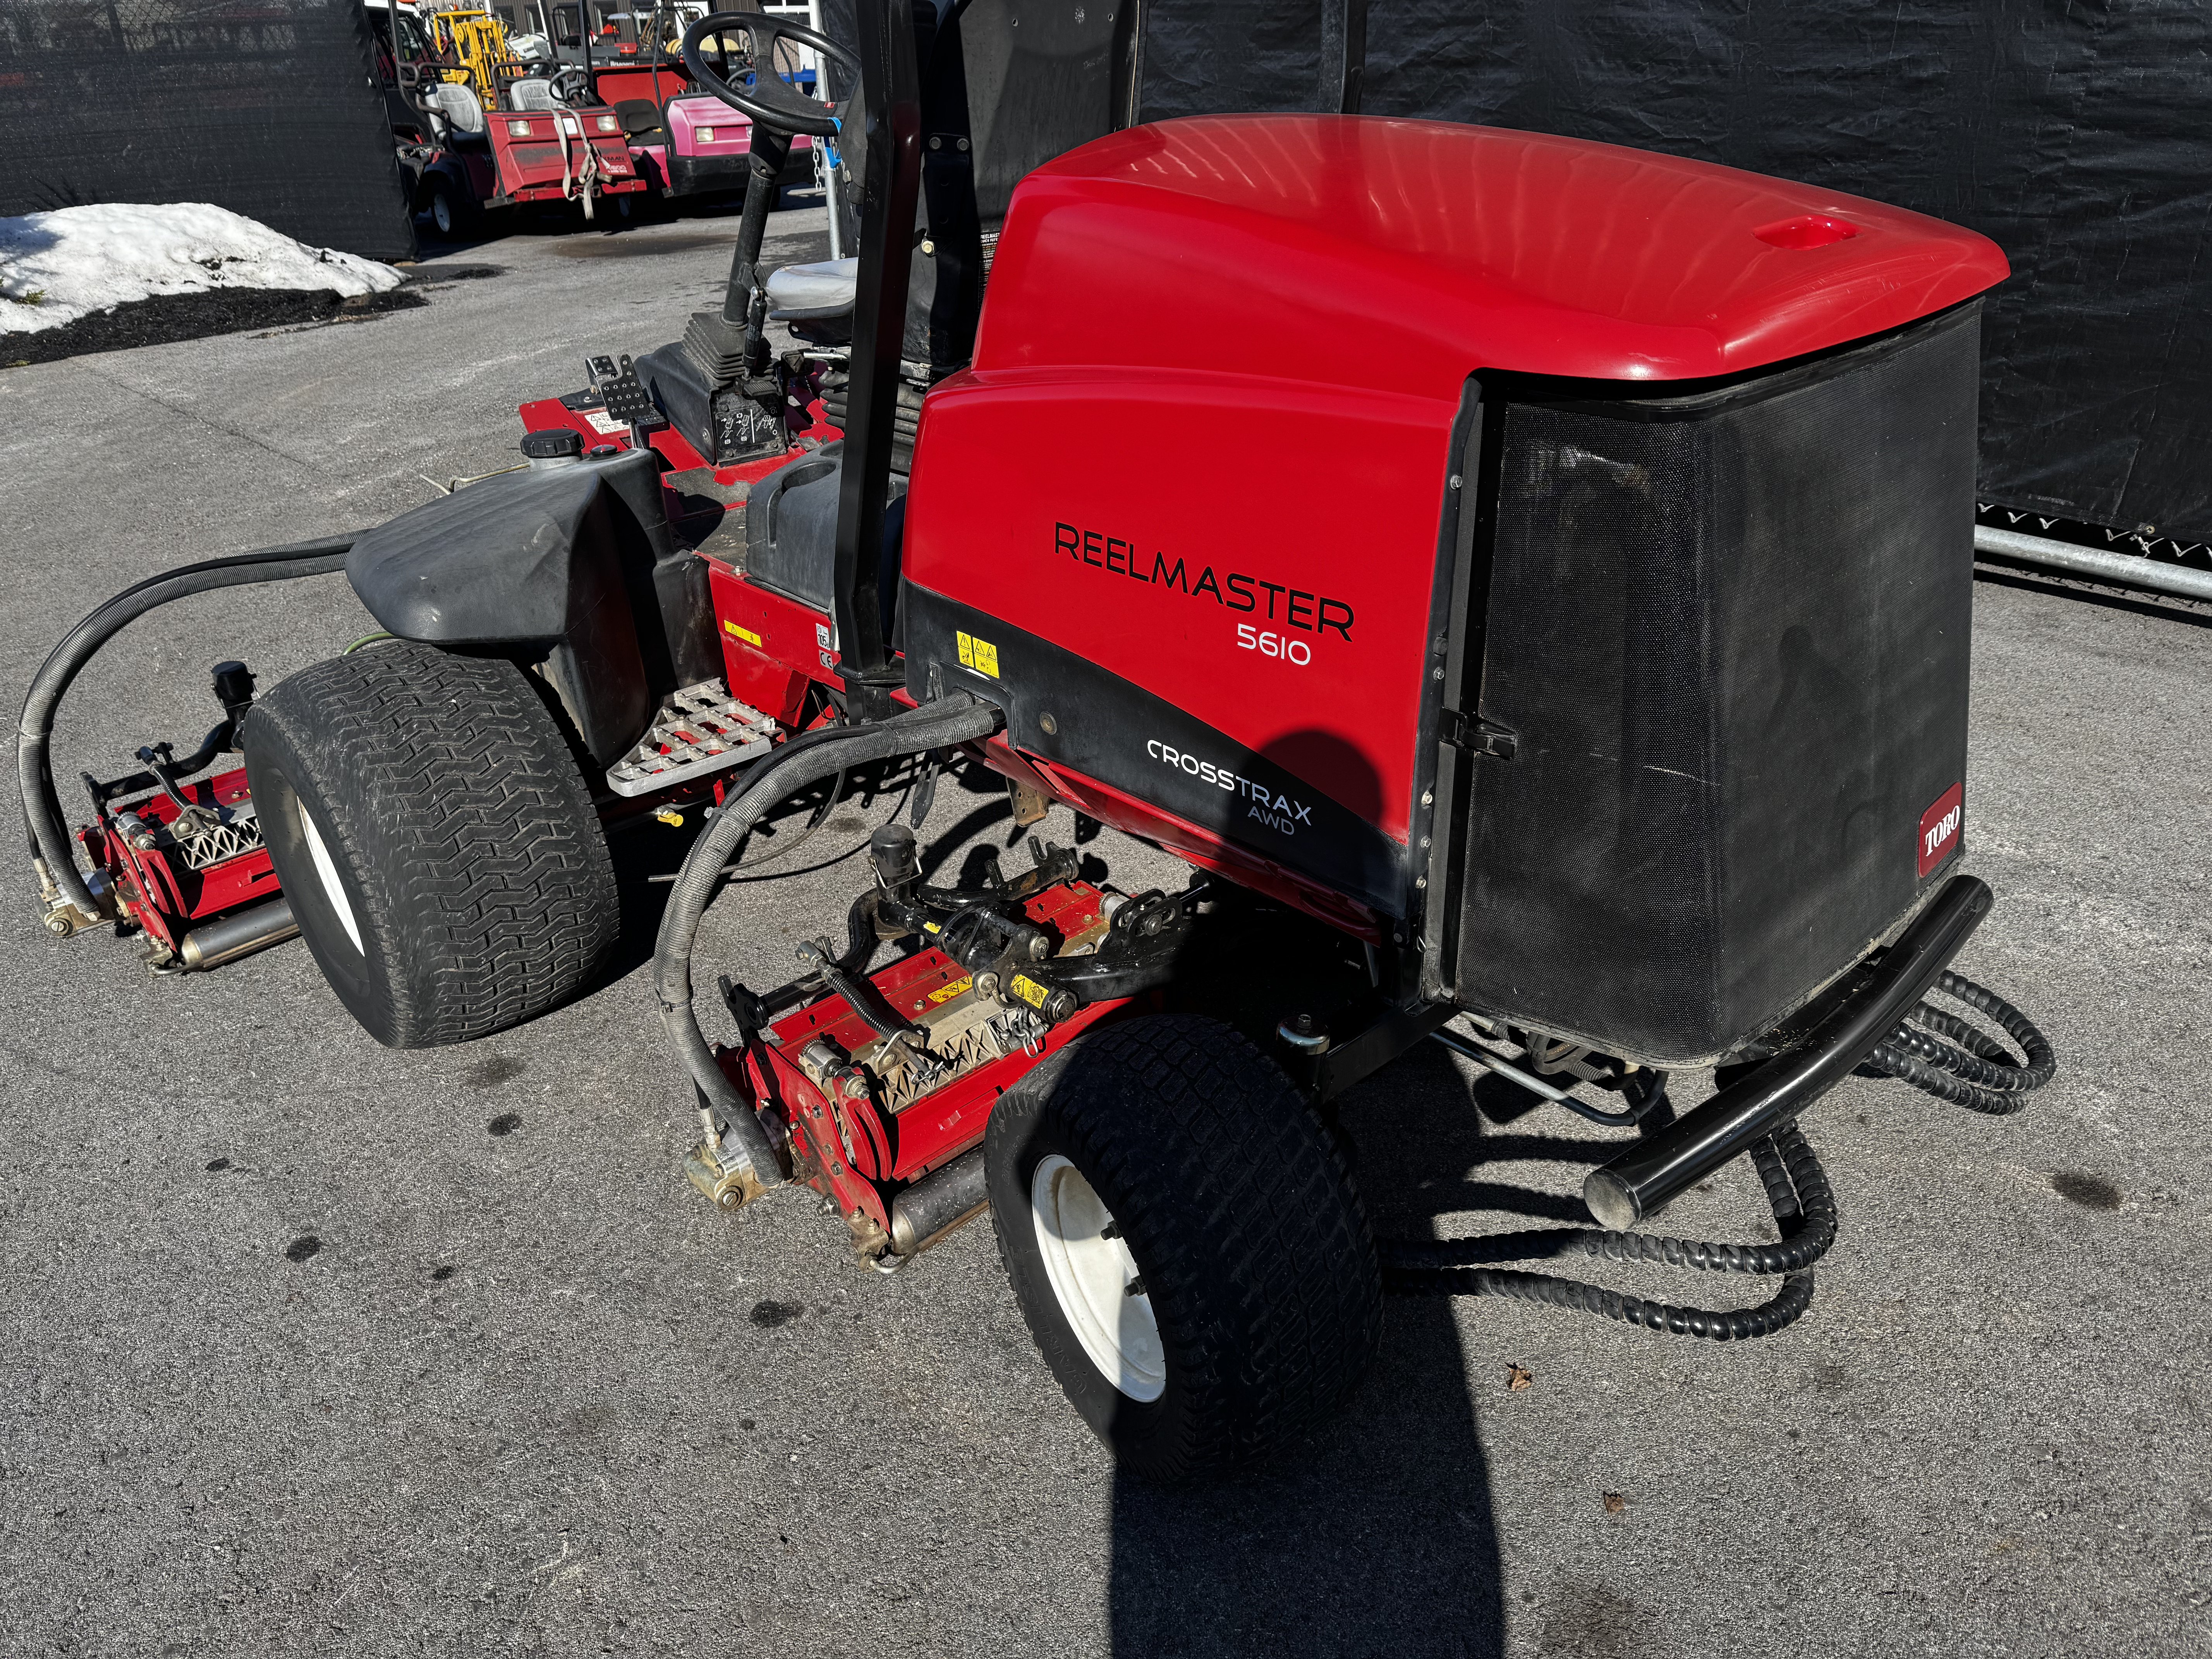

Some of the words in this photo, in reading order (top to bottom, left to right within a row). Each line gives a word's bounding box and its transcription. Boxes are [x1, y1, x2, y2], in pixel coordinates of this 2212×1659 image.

[1055, 521, 1355, 643] REELMASTER
[820, 652, 833, 669] CE
[1237, 623, 1311, 666] 5610
[1146, 739, 1312, 826] CROSSTRAX
[1247, 806, 1295, 836] AWD
[1925, 805, 1960, 857] TORO
